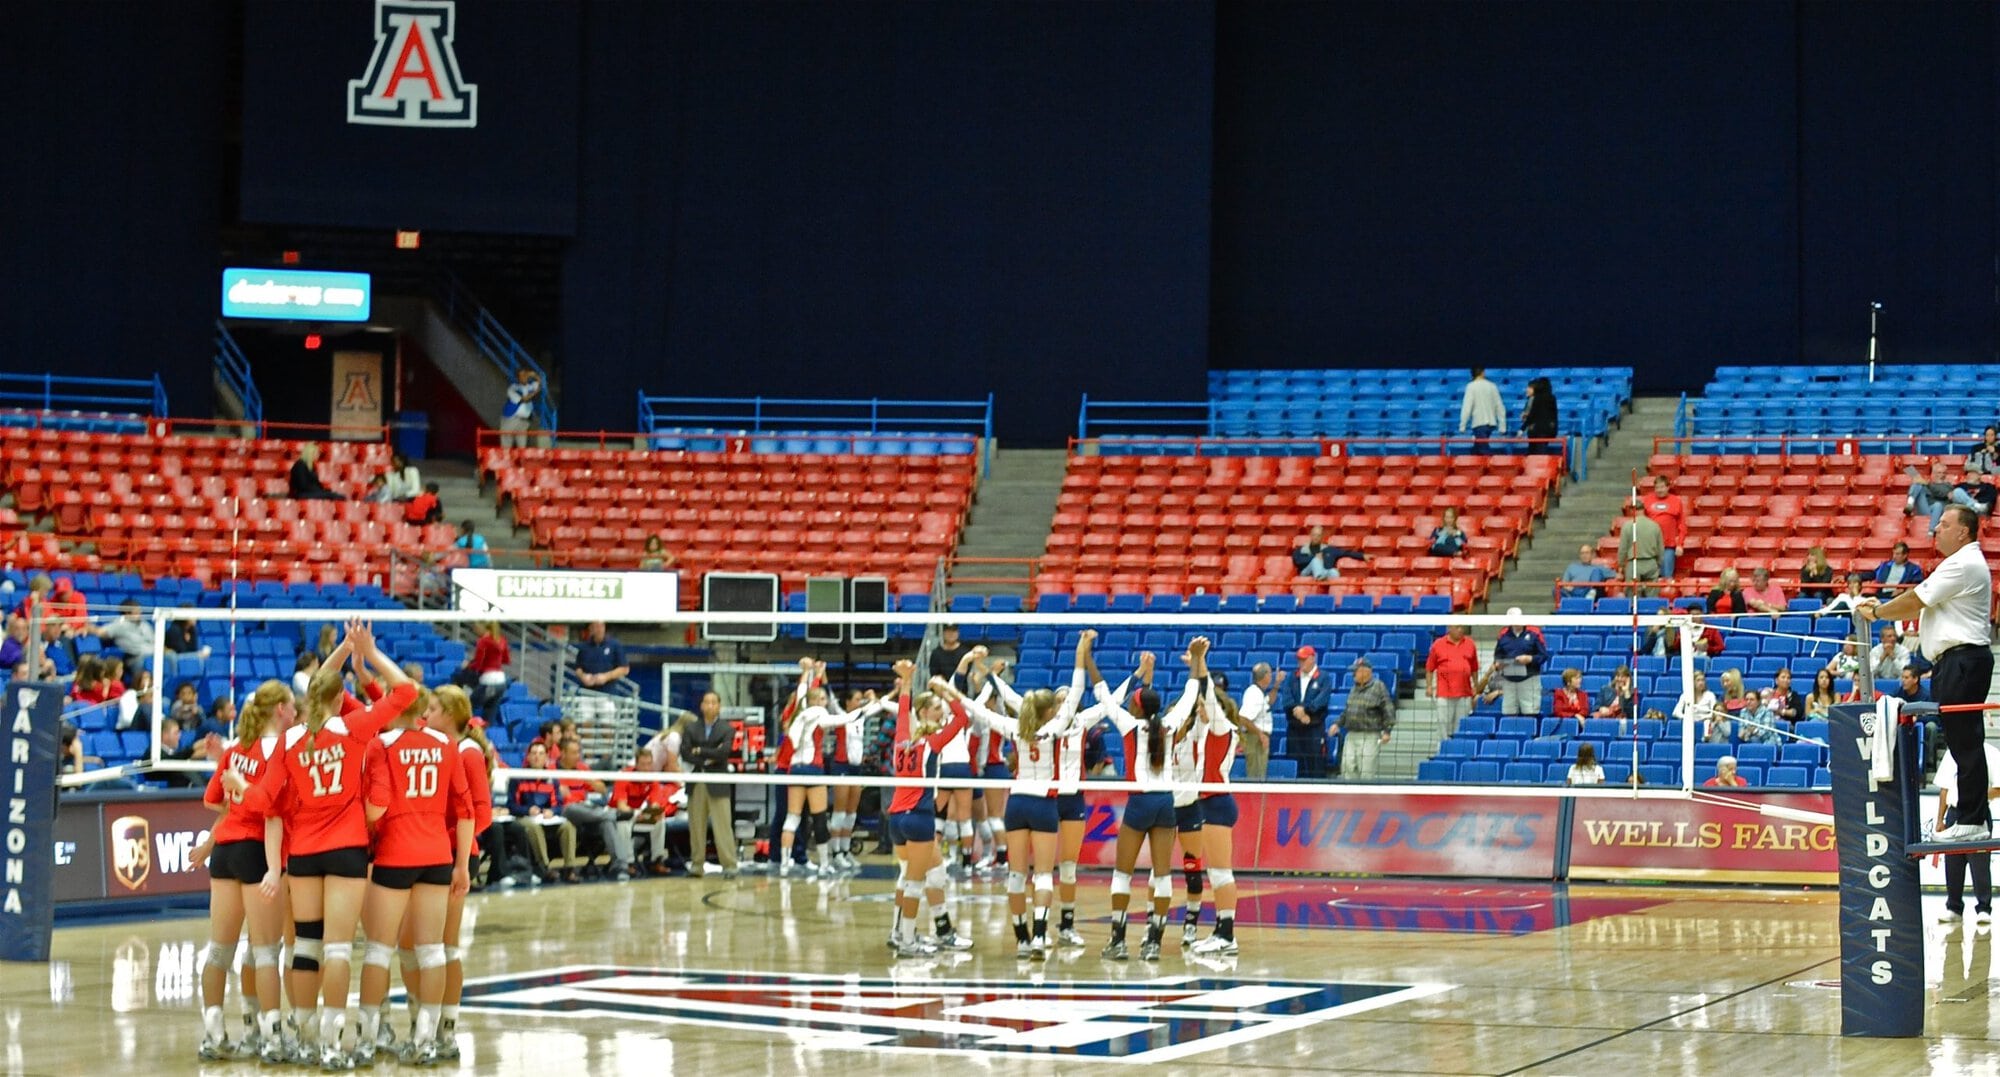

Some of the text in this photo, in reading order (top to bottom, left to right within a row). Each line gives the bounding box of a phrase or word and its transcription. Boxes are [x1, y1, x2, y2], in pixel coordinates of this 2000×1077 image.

[347, 0, 478, 128] A
[500, 576, 621, 598] SUNSTREET
[298, 742, 346, 768] UTAH
[399, 747, 443, 765] UTAH
[896, 749, 917, 771] 33
[308, 759, 343, 797] 17
[405, 764, 438, 799] 10
[4, 709, 32, 915] ARIZONA
[1276, 807, 1544, 851] WILDCATS
[1583, 819, 1723, 849] WELLS
